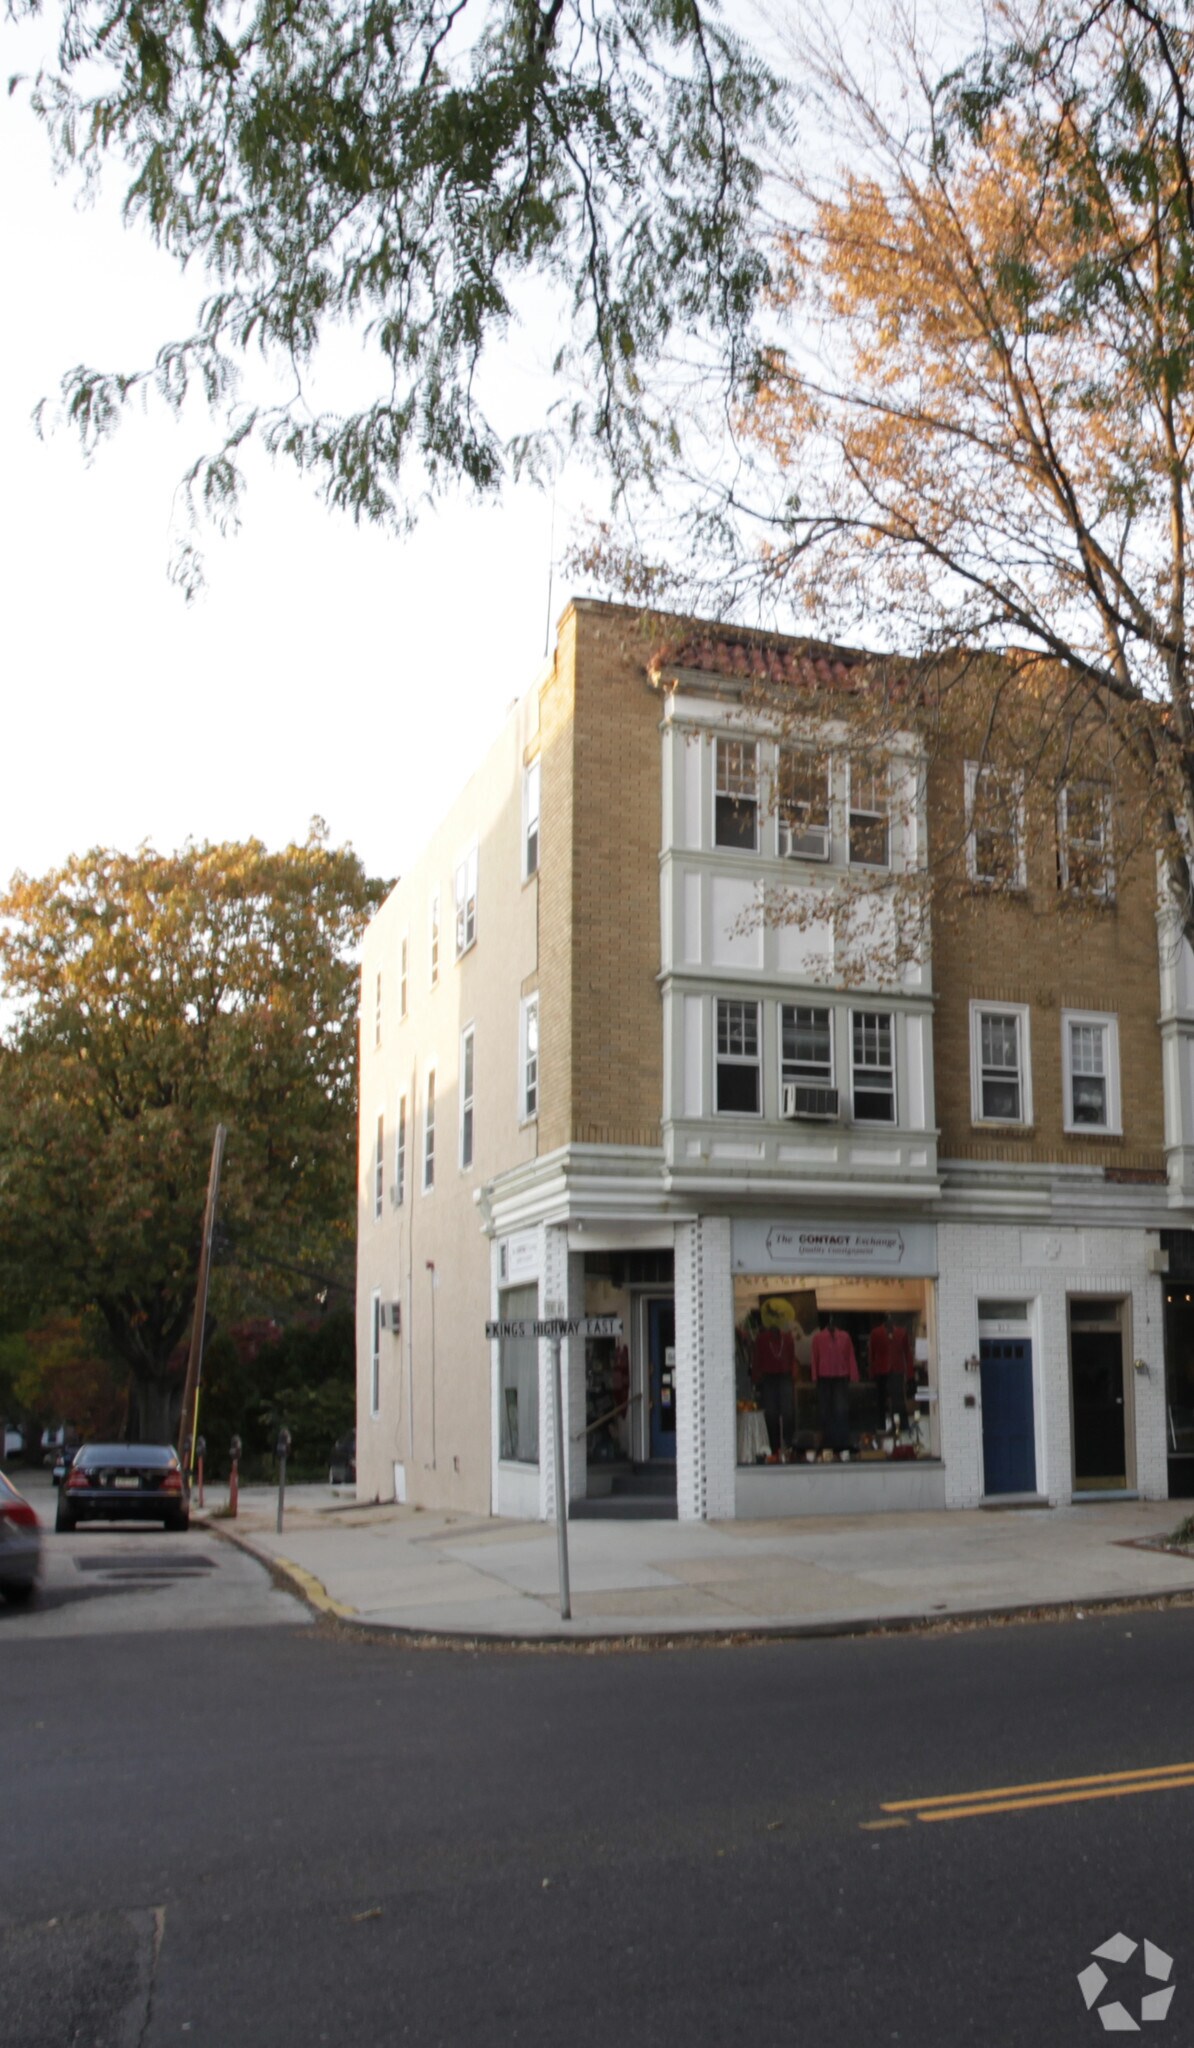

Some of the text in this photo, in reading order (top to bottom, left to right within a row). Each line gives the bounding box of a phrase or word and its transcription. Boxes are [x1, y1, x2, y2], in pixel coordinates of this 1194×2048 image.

[776, 1234, 897, 1248] The CONTACT Exchange
[493, 1319, 614, 1337] KINGS HIGHWAY EAST
